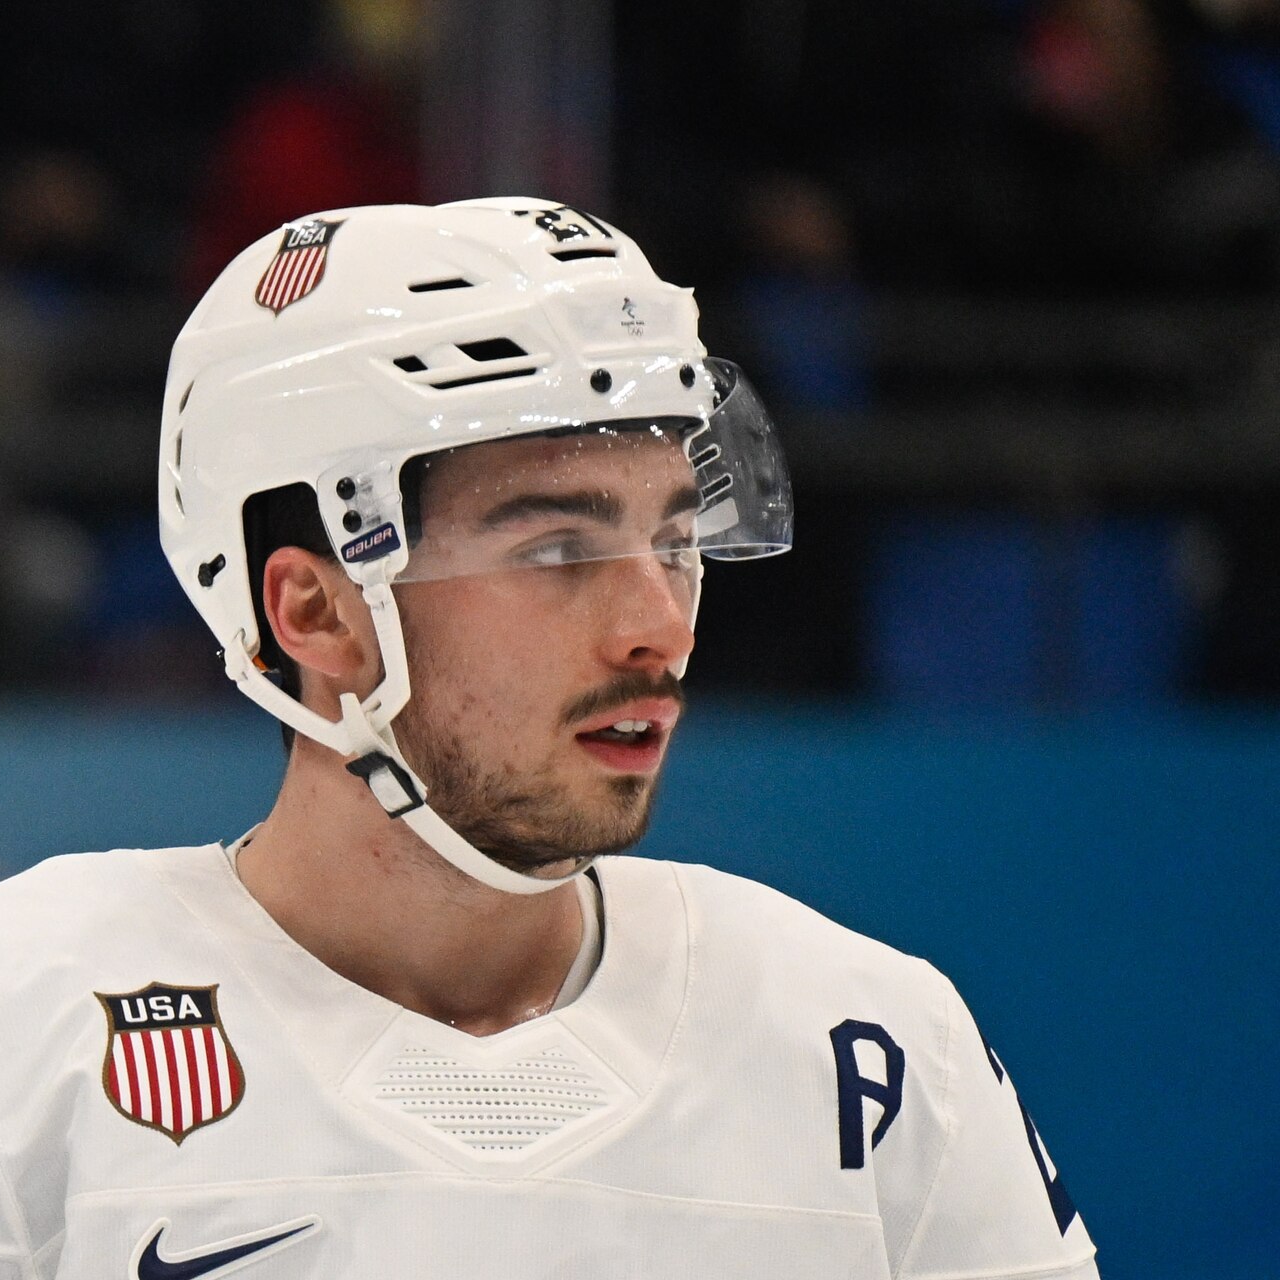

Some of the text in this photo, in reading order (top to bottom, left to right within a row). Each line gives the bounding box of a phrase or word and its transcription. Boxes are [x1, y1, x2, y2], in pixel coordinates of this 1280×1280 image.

[286, 224, 328, 248] USA
[121, 993, 203, 1022] USA
[828, 1018, 906, 1170] A
